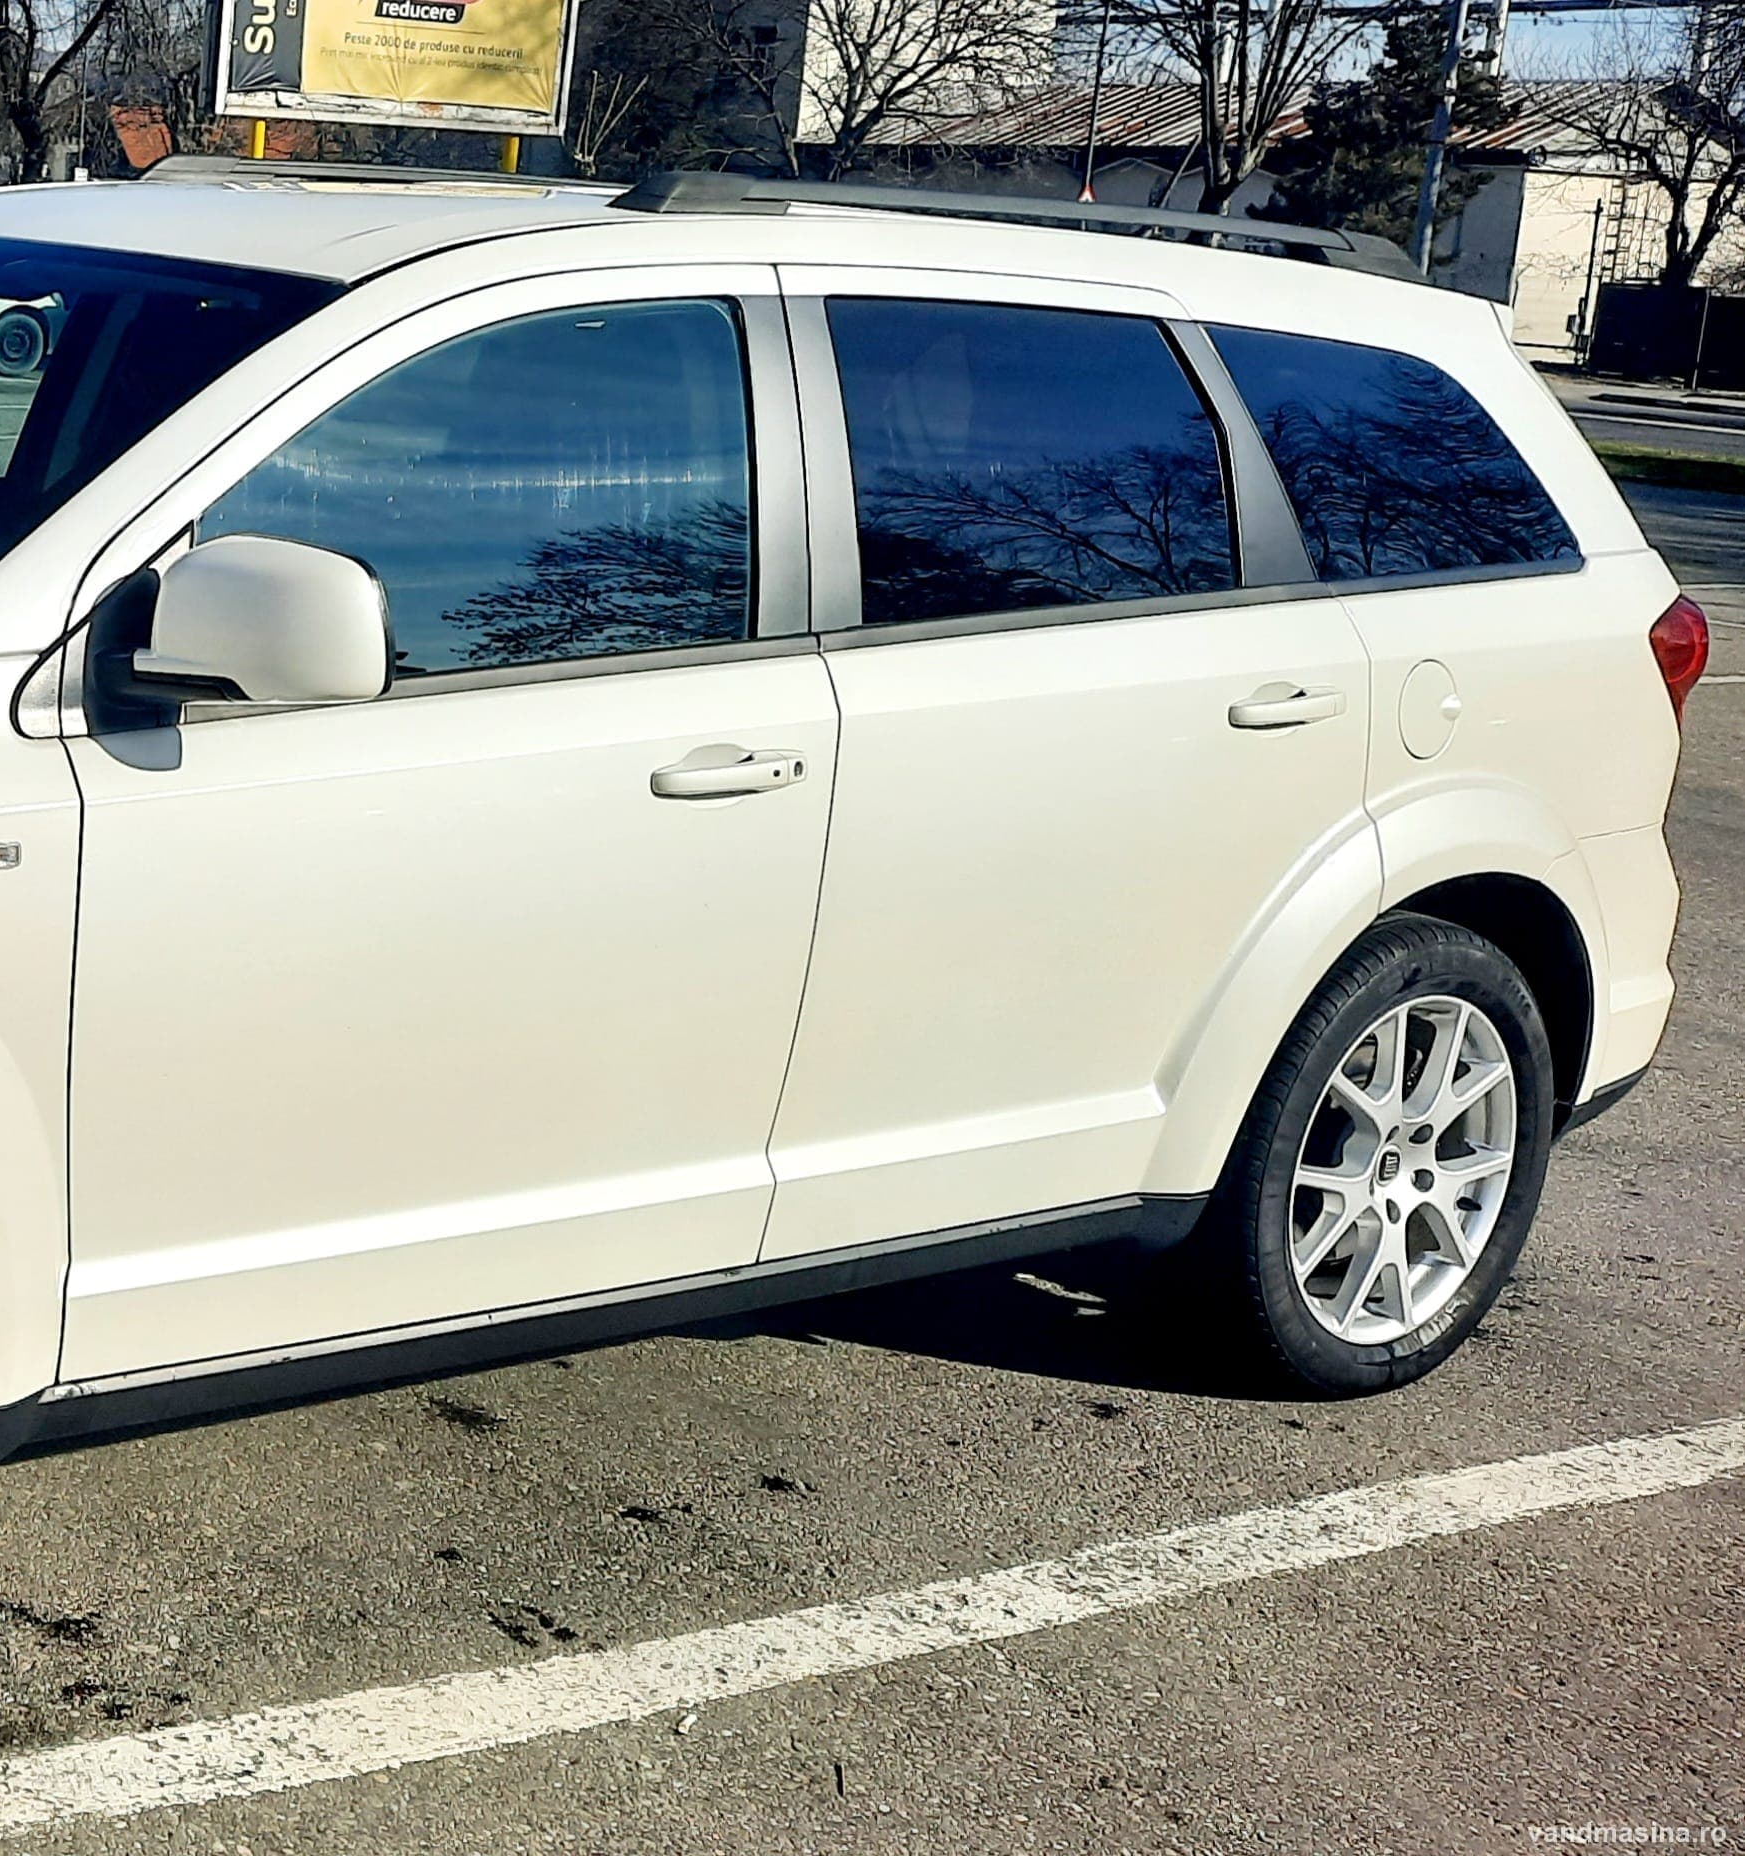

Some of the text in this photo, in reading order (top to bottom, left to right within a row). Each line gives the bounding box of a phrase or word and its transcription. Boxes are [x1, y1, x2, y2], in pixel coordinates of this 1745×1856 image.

[382, 1, 456, 21] reducere
[344, 32, 372, 45] Peste
[375, 35, 401, 48] 2000
[403, 38, 416, 50] de
[419, 41, 459, 54] produse
[462, 45, 475, 55] cu
